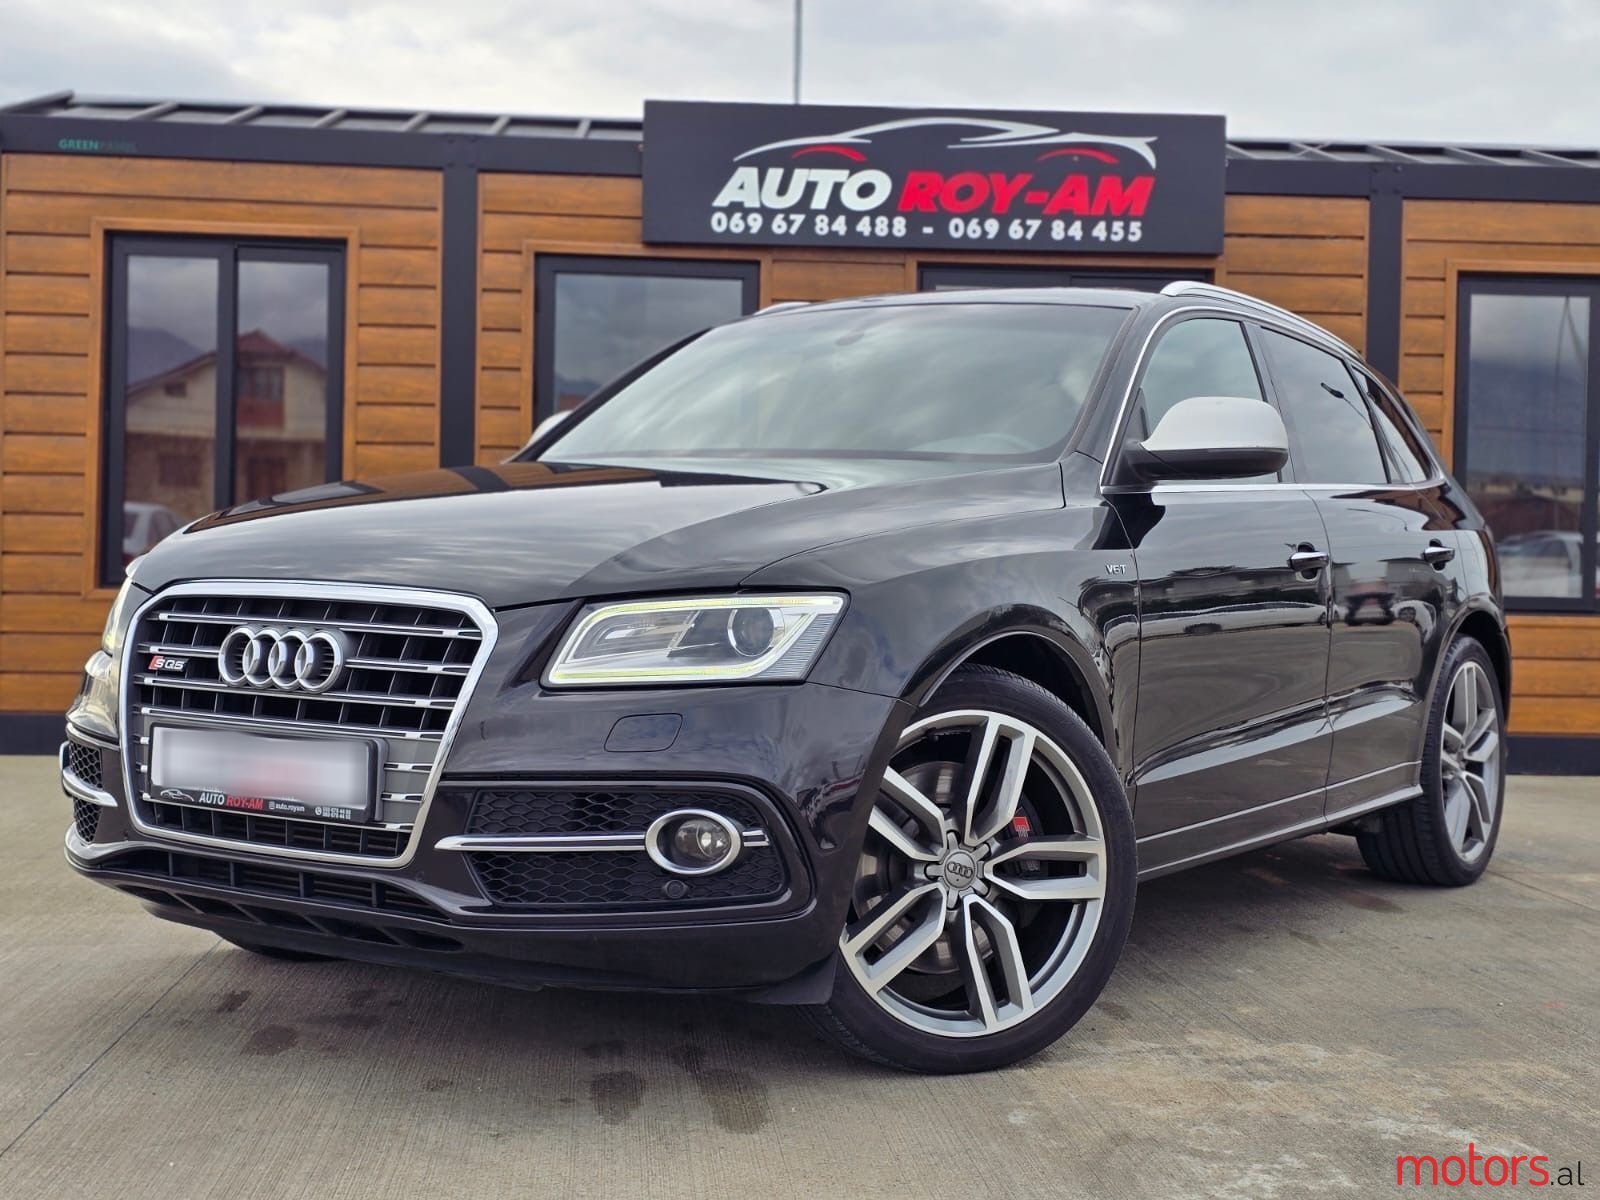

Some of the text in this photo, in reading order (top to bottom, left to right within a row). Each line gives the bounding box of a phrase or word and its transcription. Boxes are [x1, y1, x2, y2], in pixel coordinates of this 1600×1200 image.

[712, 166, 1156, 217] AUTO ROY-AM
[711, 211, 763, 234] 069
[771, 213, 806, 235] 67
[814, 214, 847, 236] 84
[856, 215, 907, 237] 488
[949, 217, 1000, 239] 069
[1008, 218, 1042, 240] 67
[1050, 219, 1084, 241] 84
[1091, 220, 1143, 242] 455
[199, 792, 264, 810] AUTO ROY-AM
